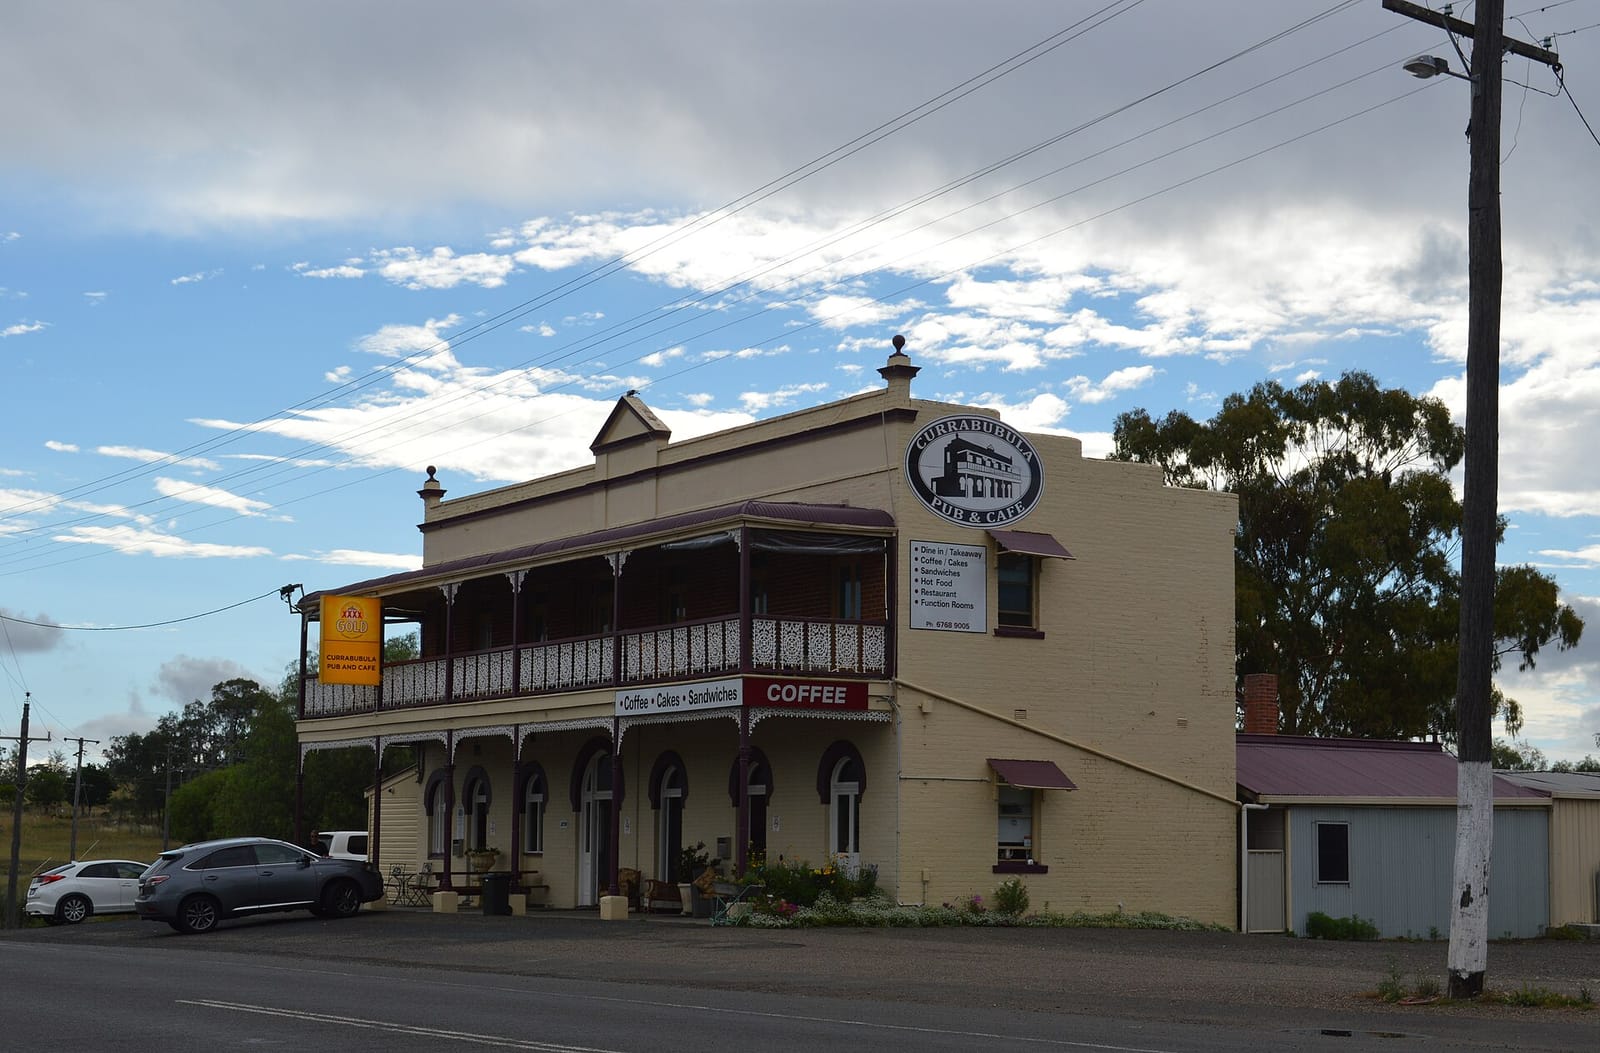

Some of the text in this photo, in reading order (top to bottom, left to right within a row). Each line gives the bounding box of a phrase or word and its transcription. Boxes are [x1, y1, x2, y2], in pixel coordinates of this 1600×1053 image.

[916, 420, 1033, 463] CURRABUBULA
[931, 497, 1025, 523] PUB & CAFE
[920, 546, 936, 554] Dine
[938, 547, 944, 555] in
[950, 548, 982, 559] Takeaway
[920, 556, 942, 565] Coffee
[948, 558, 968, 568] Cakes
[920, 567, 960, 577] Sandwiches
[920, 578, 952, 587] Hot Food
[920, 588, 956, 598] Restaurant
[920, 599, 974, 610] Function Rooms
[341, 610, 362, 619] XXXX
[336, 620, 368, 633] GOLD
[326, 654, 377, 662] CURRABUBULA
[624, 686, 738, 710] Coffee Cakes Sandwiches
[767, 684, 847, 704] COFFEE
